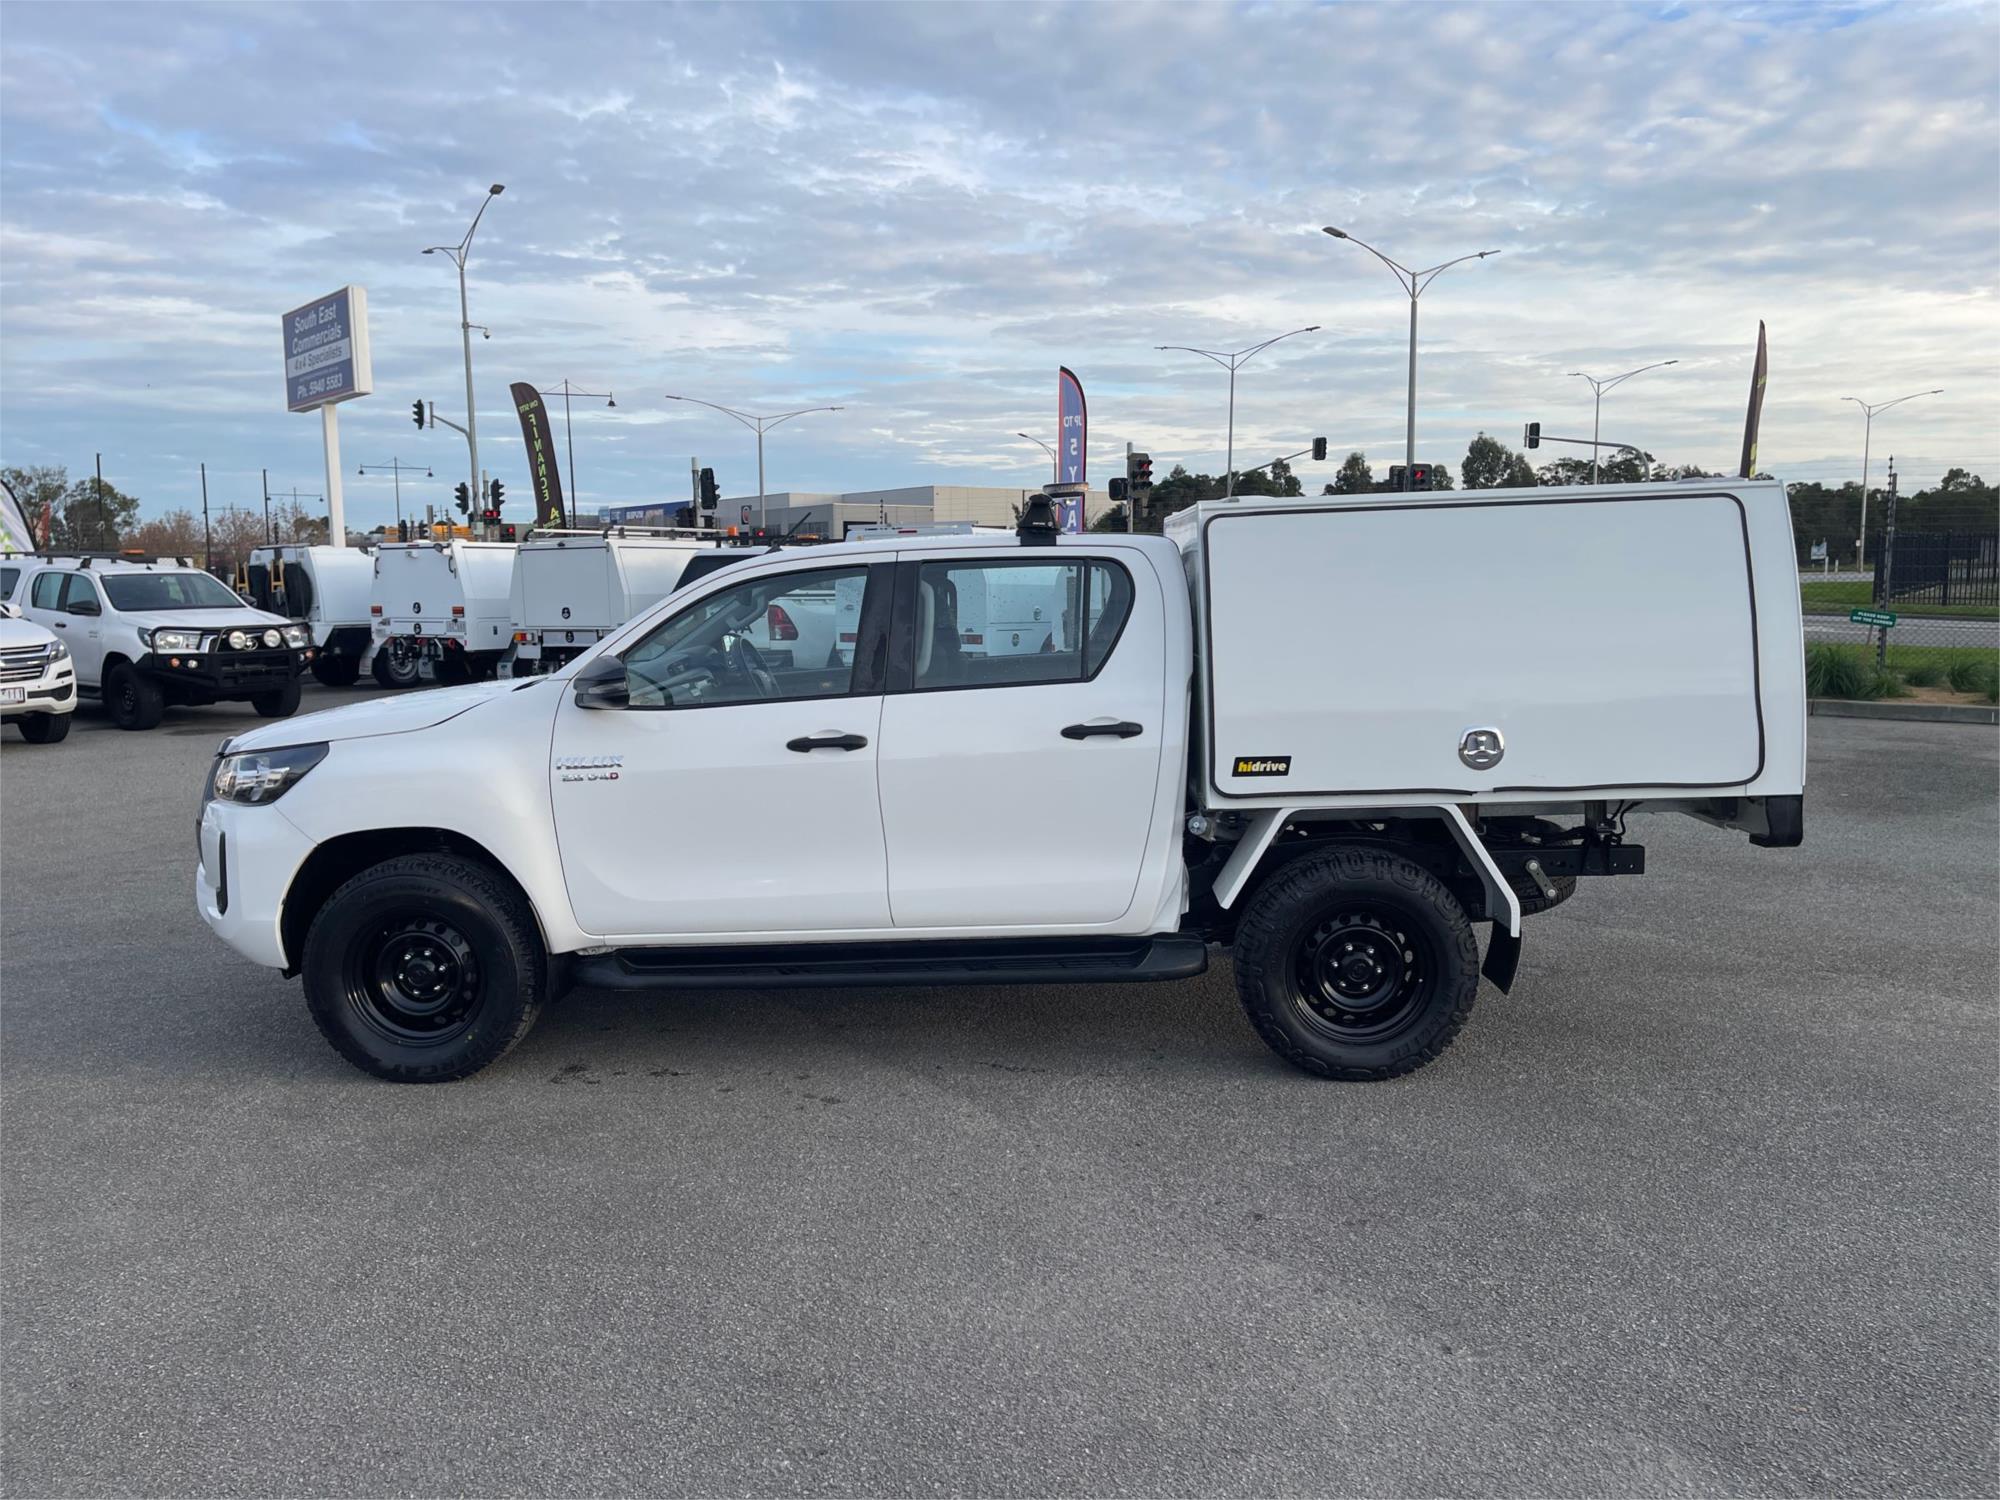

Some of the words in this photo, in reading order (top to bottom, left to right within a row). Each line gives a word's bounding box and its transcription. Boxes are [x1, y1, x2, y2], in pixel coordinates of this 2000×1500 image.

[294, 310, 317, 334] South
[318, 302, 337, 324] East
[292, 321, 342, 355] Commercials
[556, 756, 624, 770] HILUX
[1237, 760, 1287, 772] hidrive
